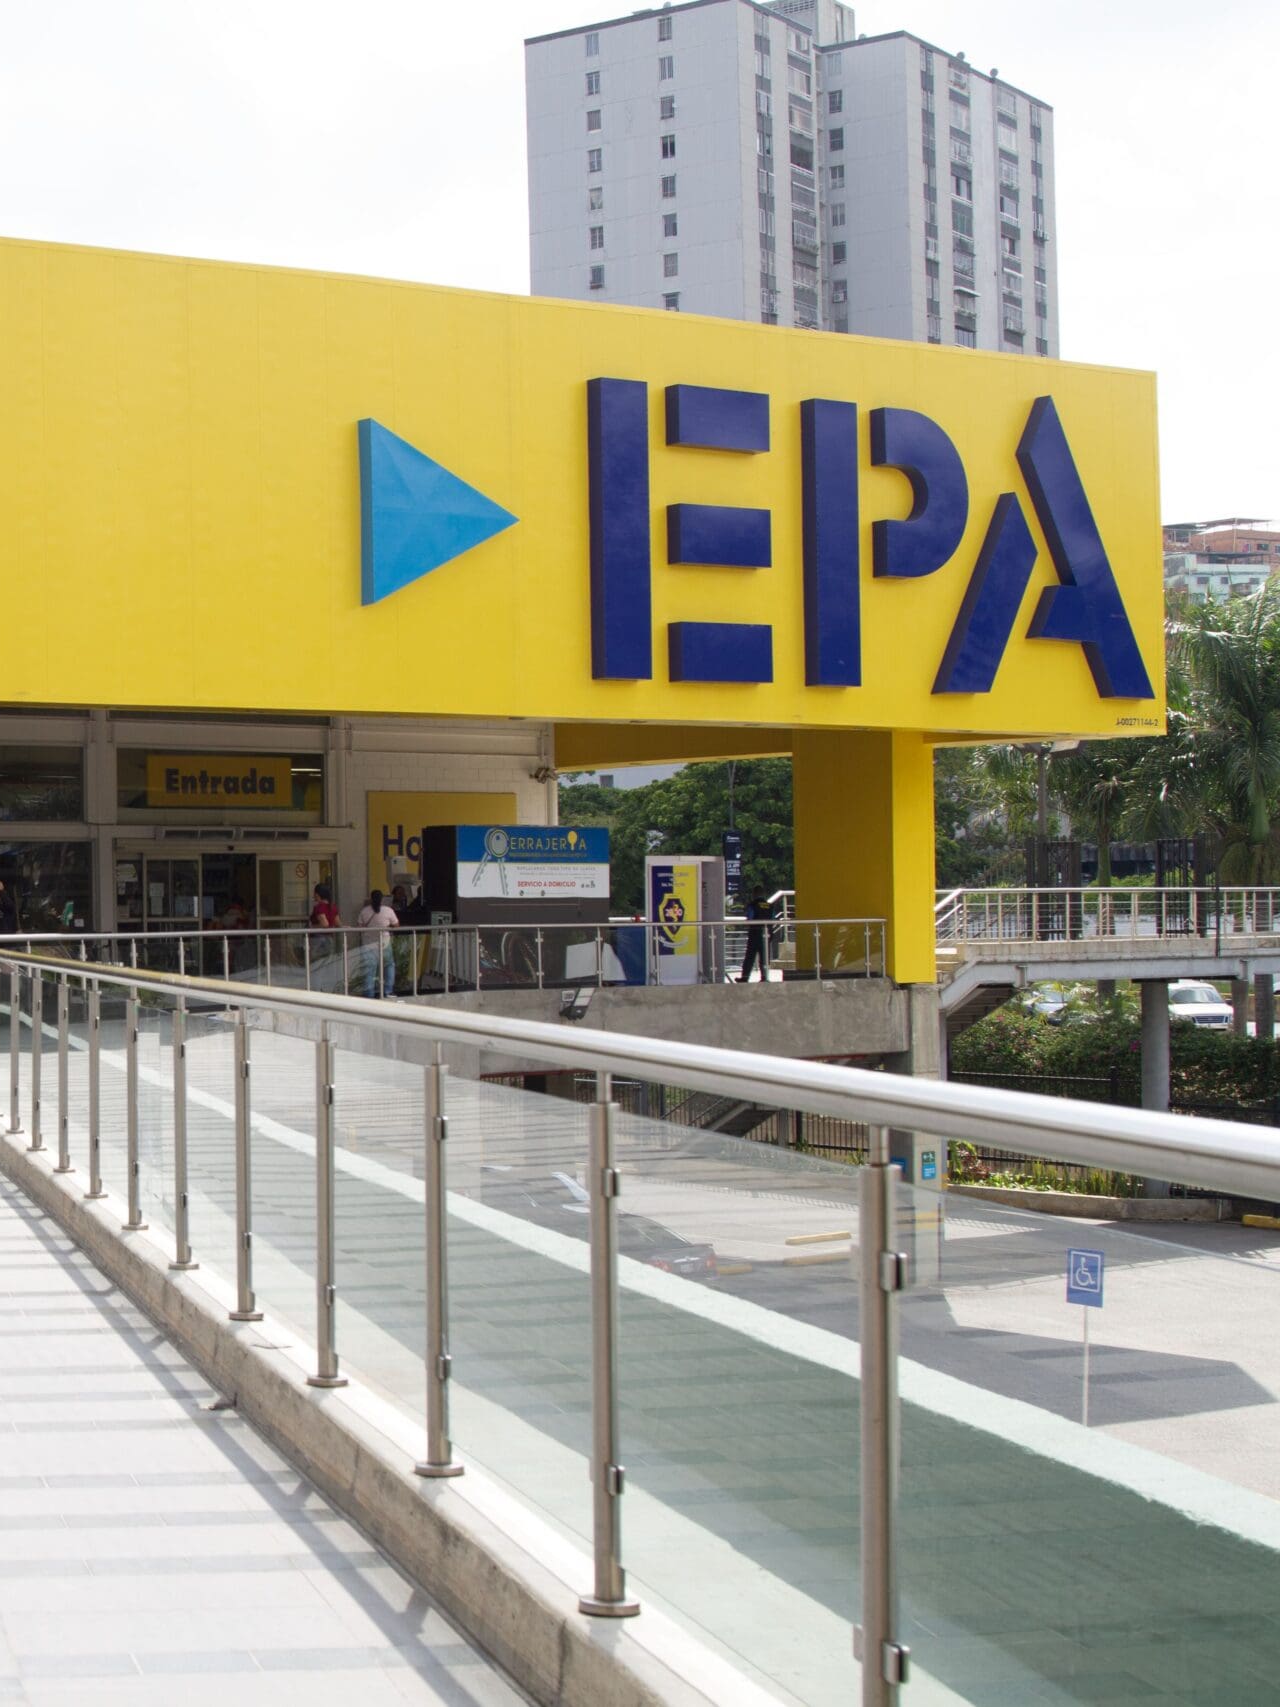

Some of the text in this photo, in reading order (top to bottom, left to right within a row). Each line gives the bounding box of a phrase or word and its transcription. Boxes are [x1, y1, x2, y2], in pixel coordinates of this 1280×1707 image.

[586, 377, 1156, 700] EPA
[165, 767, 275, 795] Entrada
[517, 880, 542, 888] SERVICIO
